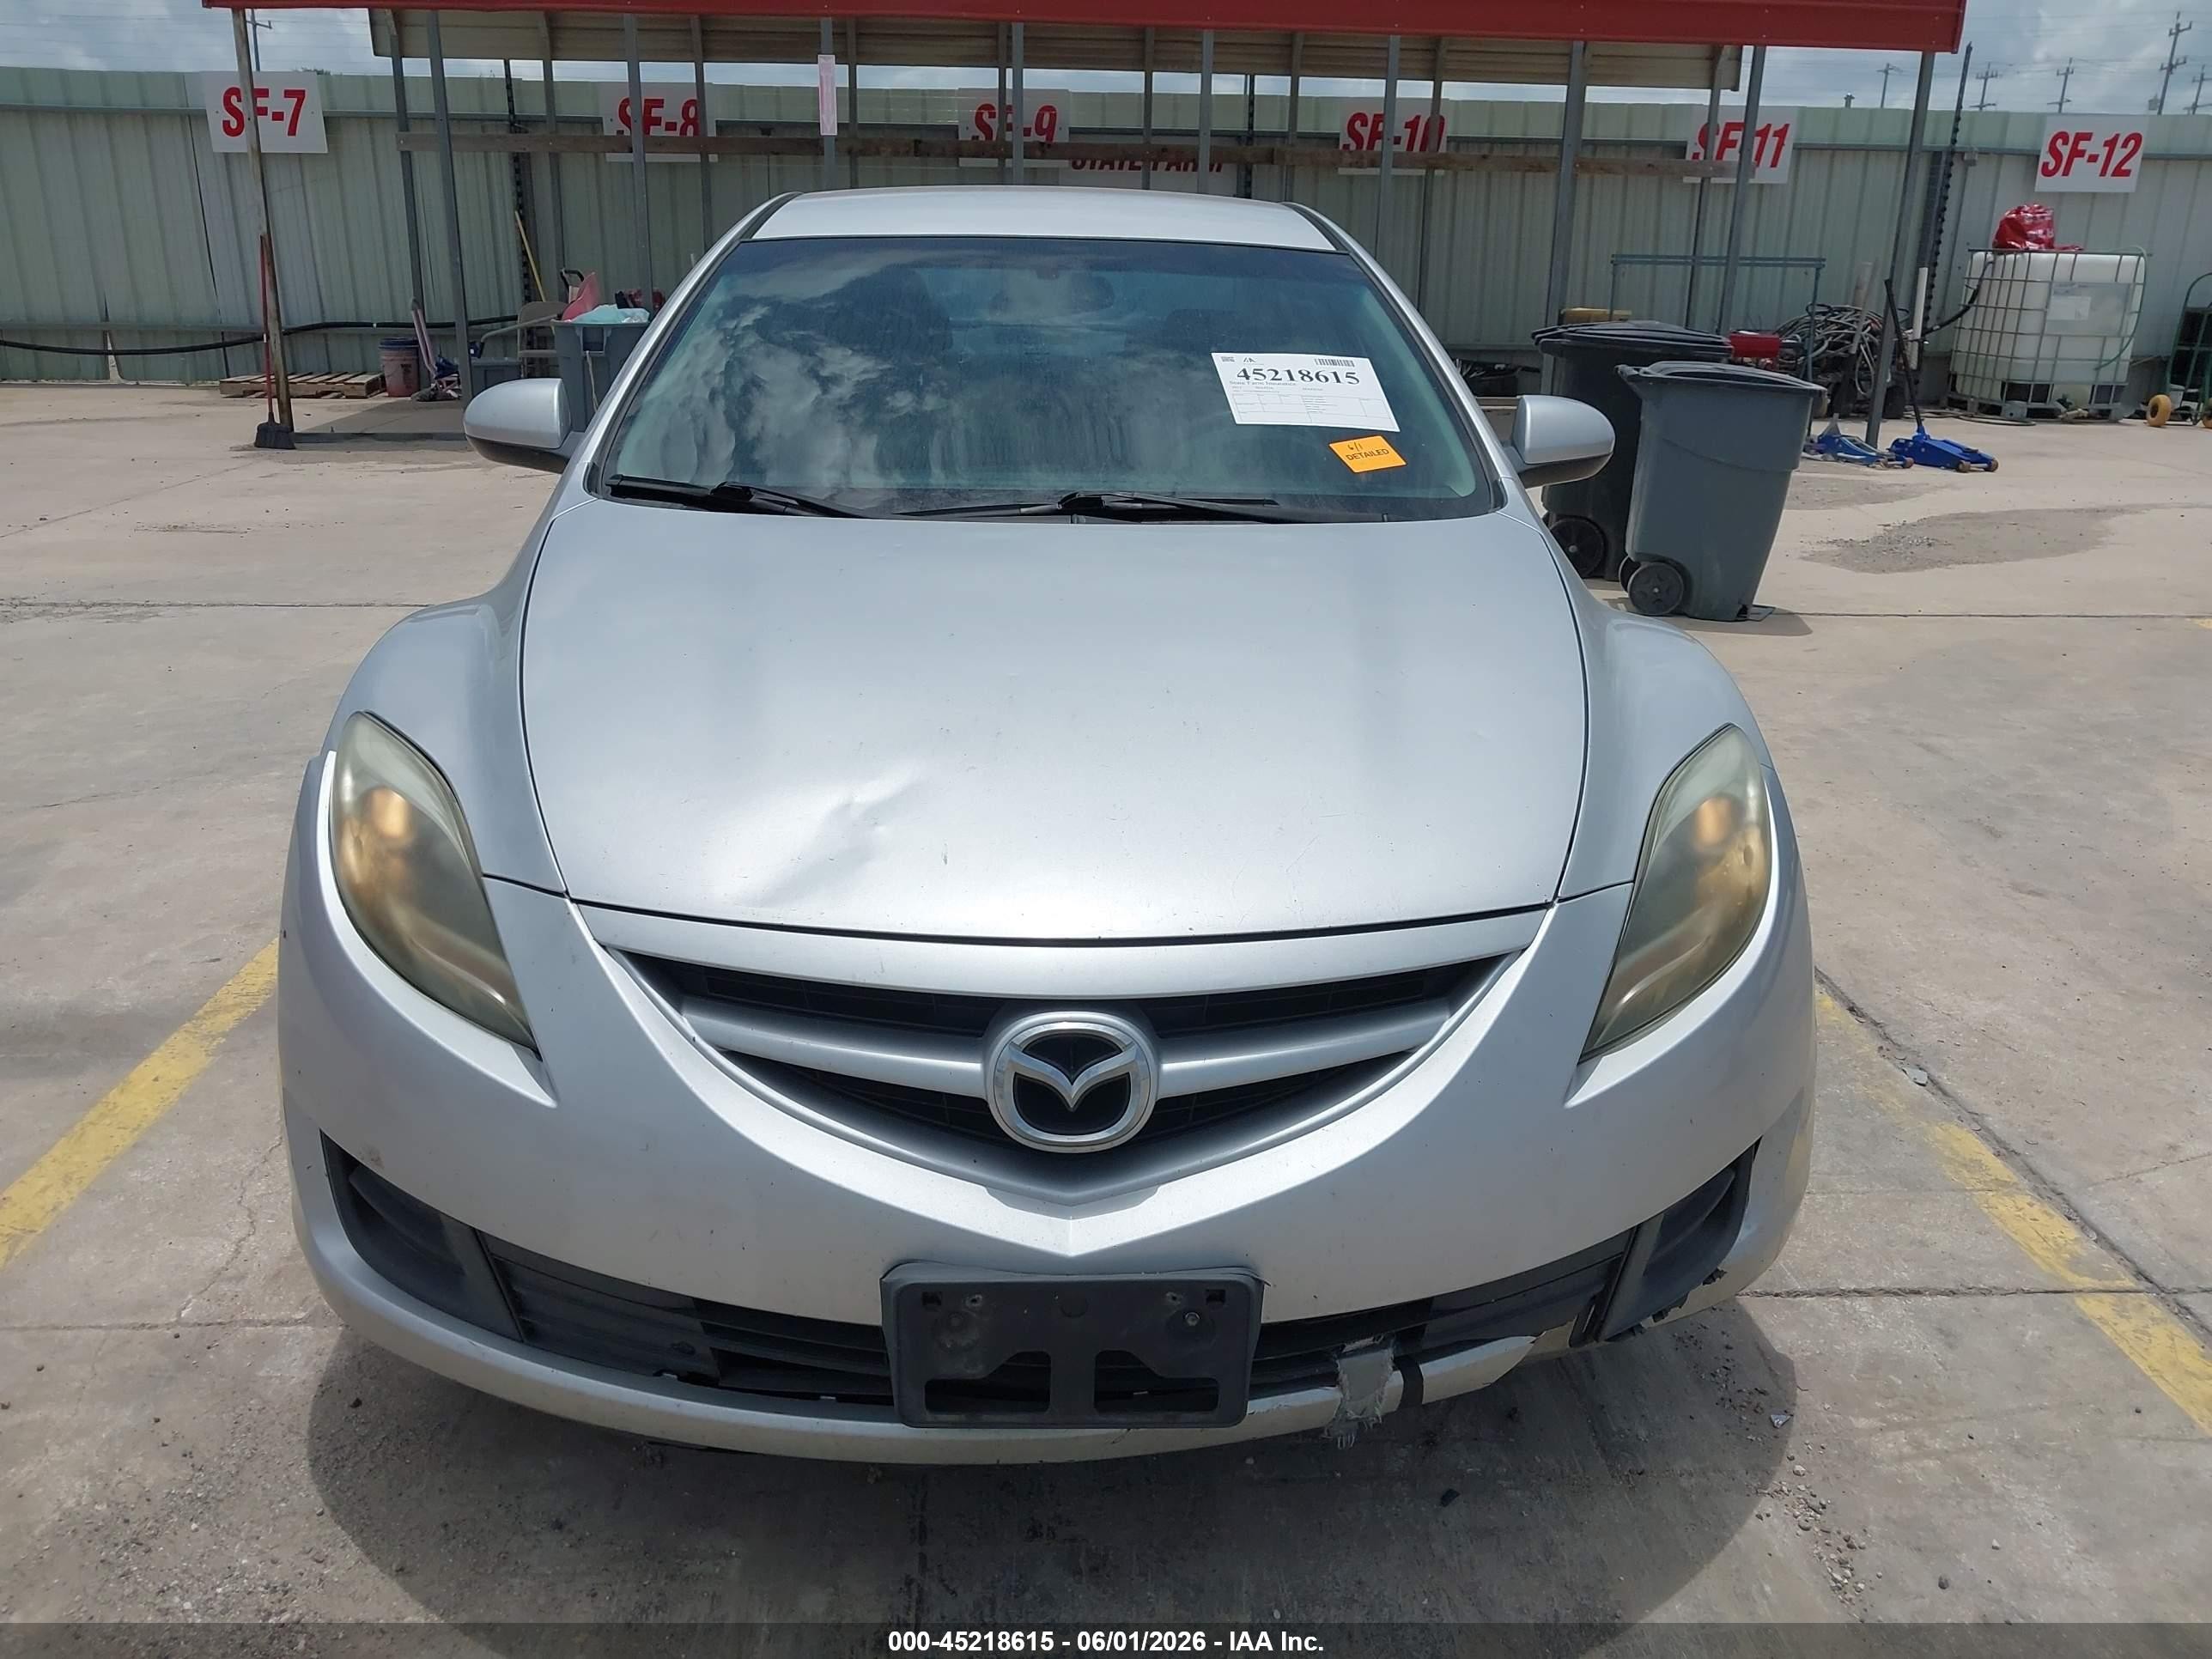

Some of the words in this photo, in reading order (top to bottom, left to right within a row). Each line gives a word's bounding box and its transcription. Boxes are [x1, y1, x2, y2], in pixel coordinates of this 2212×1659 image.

[222, 87, 306, 138] SF-7
[1692, 121, 1790, 169] F11
[2039, 131, 2143, 179] SF-12
[1237, 368, 1360, 385] 45218615
[1346, 448, 1389, 461] DETAILED
